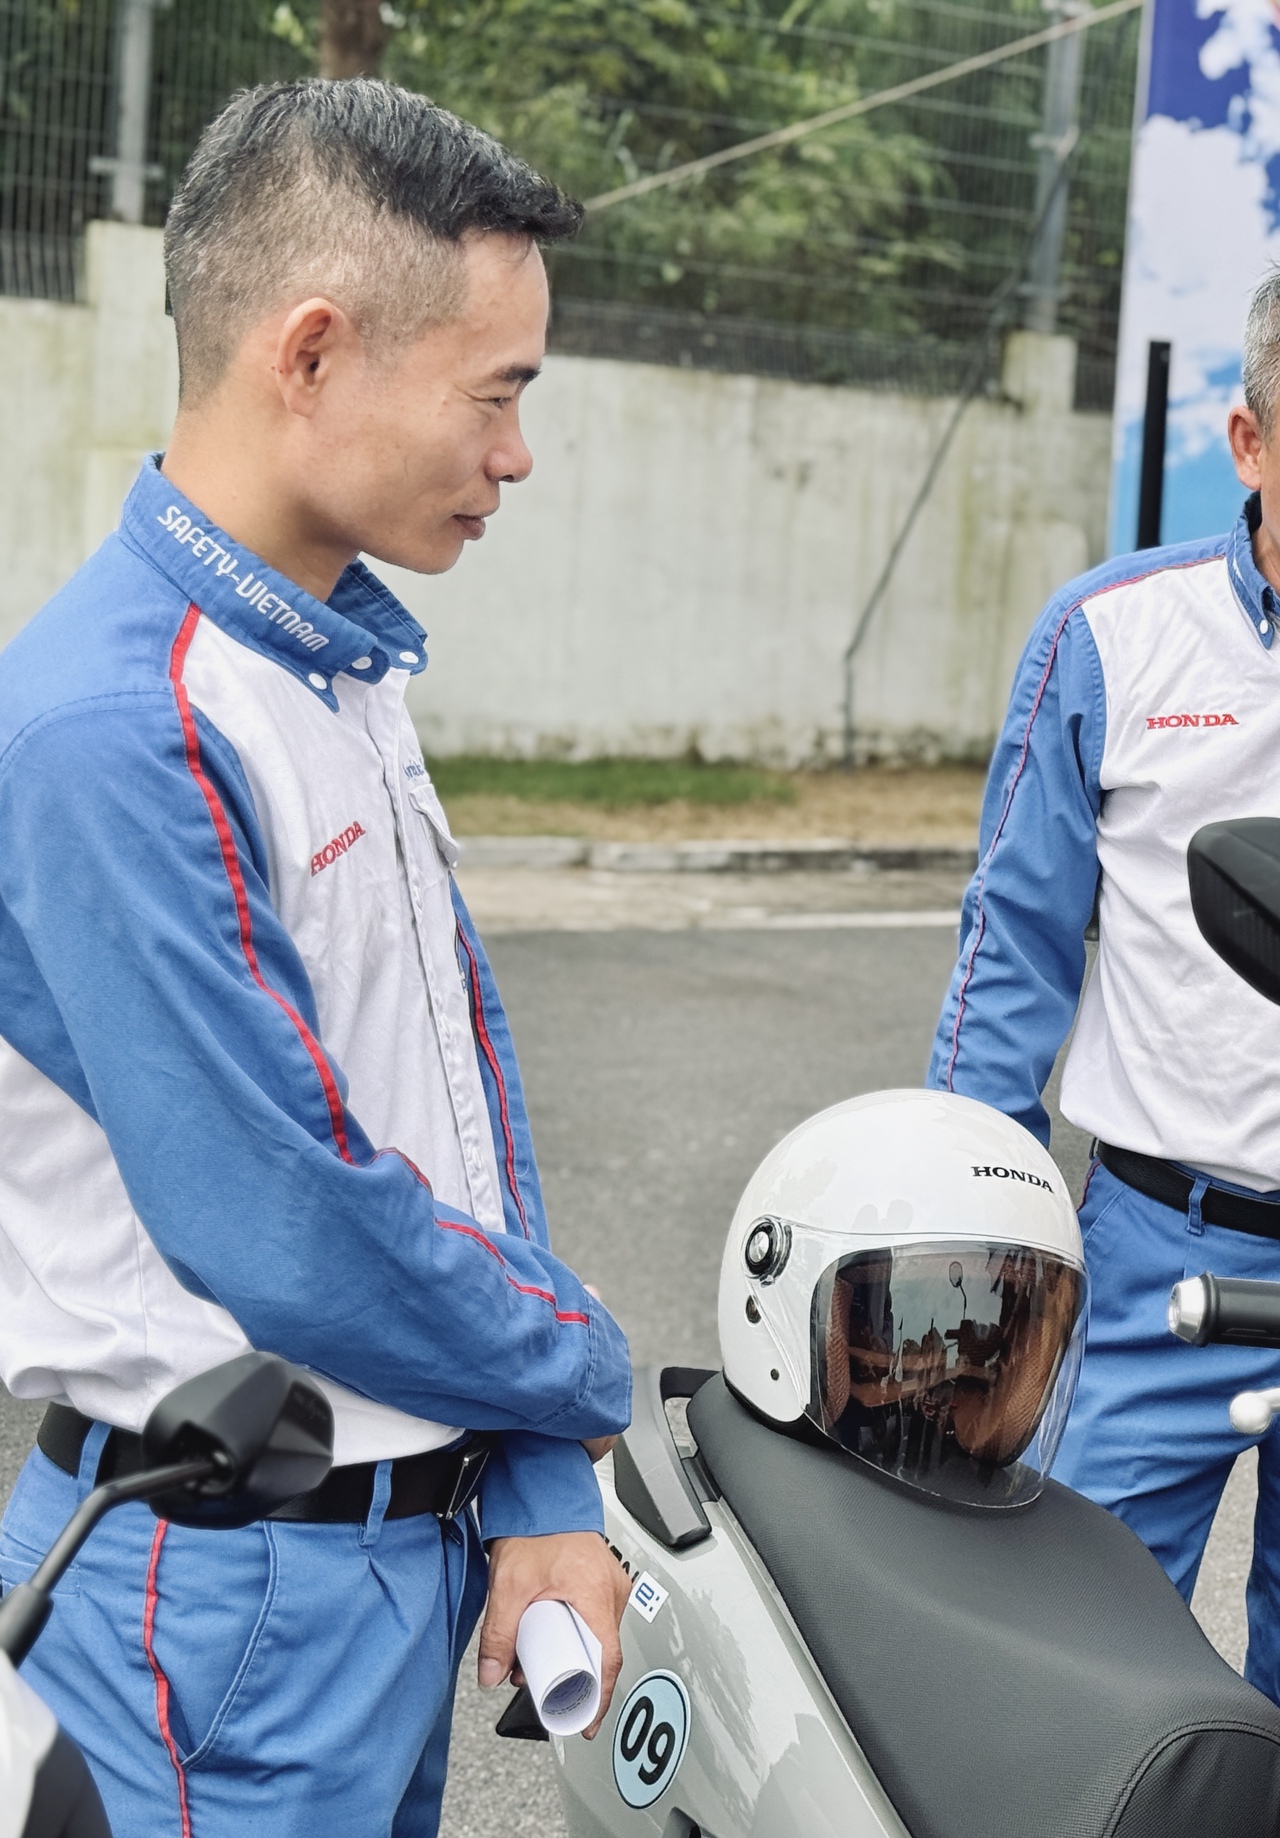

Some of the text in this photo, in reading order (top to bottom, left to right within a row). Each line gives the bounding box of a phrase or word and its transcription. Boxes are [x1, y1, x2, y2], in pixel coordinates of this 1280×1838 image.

[157, 505, 330, 651] SAFETY-VIETNAM
[1146, 713, 1239, 730] HONDA
[310, 820, 366, 877] HONDA
[970, 1166, 1055, 1194] HONDA
[620, 1695, 676, 1786] 09
